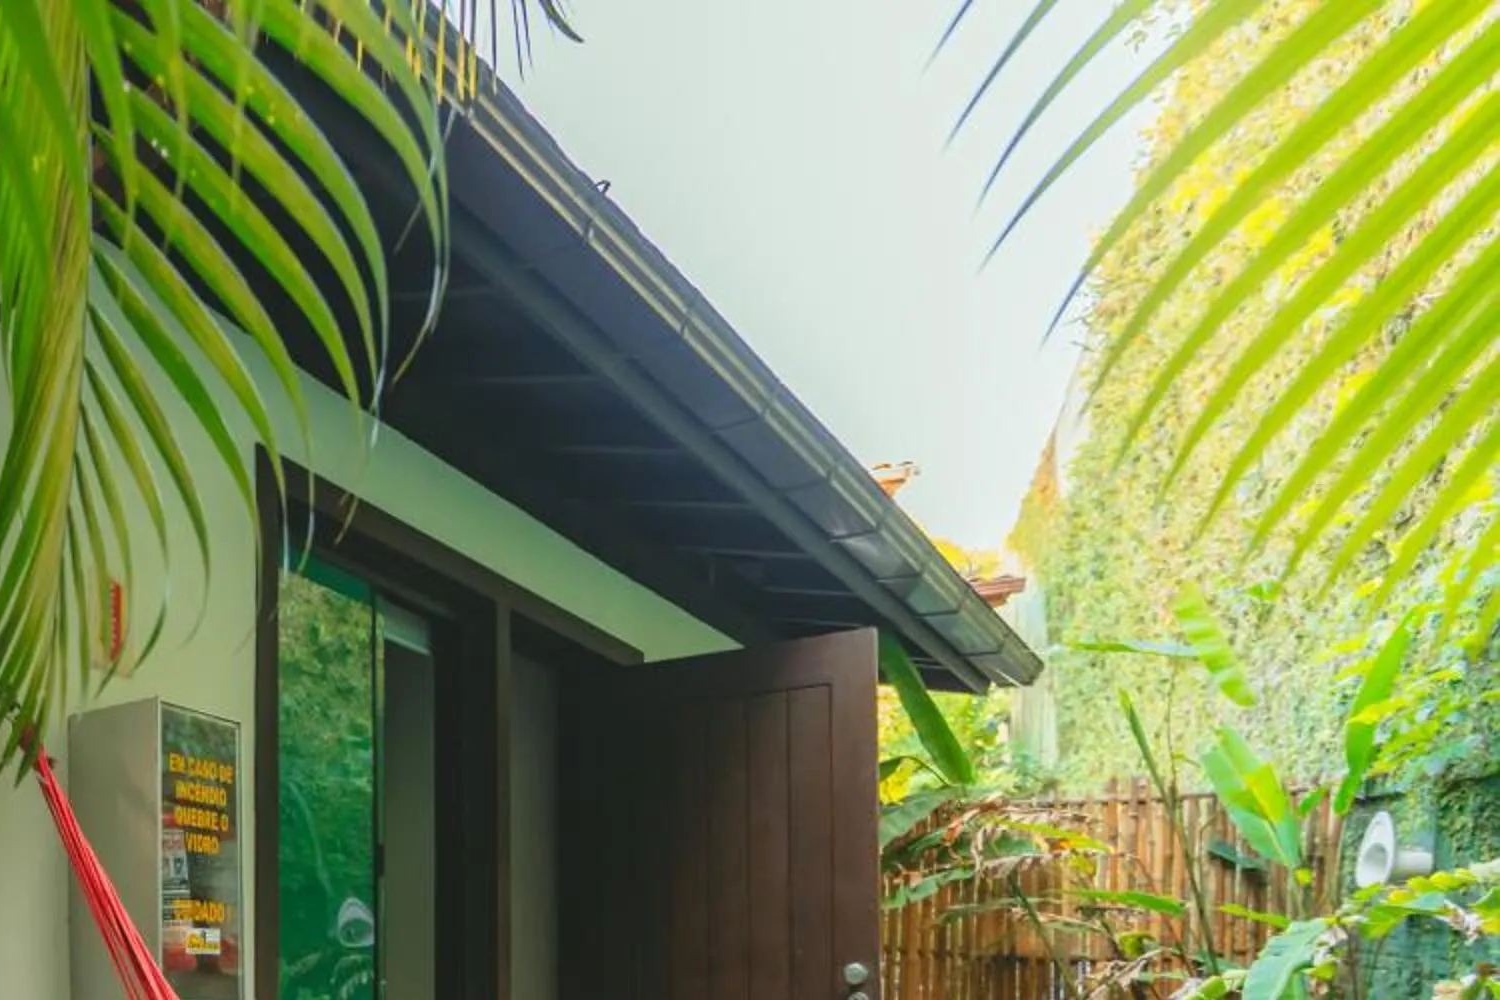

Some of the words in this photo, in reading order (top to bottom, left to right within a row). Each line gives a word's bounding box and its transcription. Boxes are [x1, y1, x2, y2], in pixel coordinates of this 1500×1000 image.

[188, 757, 217, 780] CASO
[220, 764, 233, 784] DE
[174, 806, 218, 831] QUEBRE
[220, 813, 229, 832] O
[185, 831, 219, 855] VIDRO
